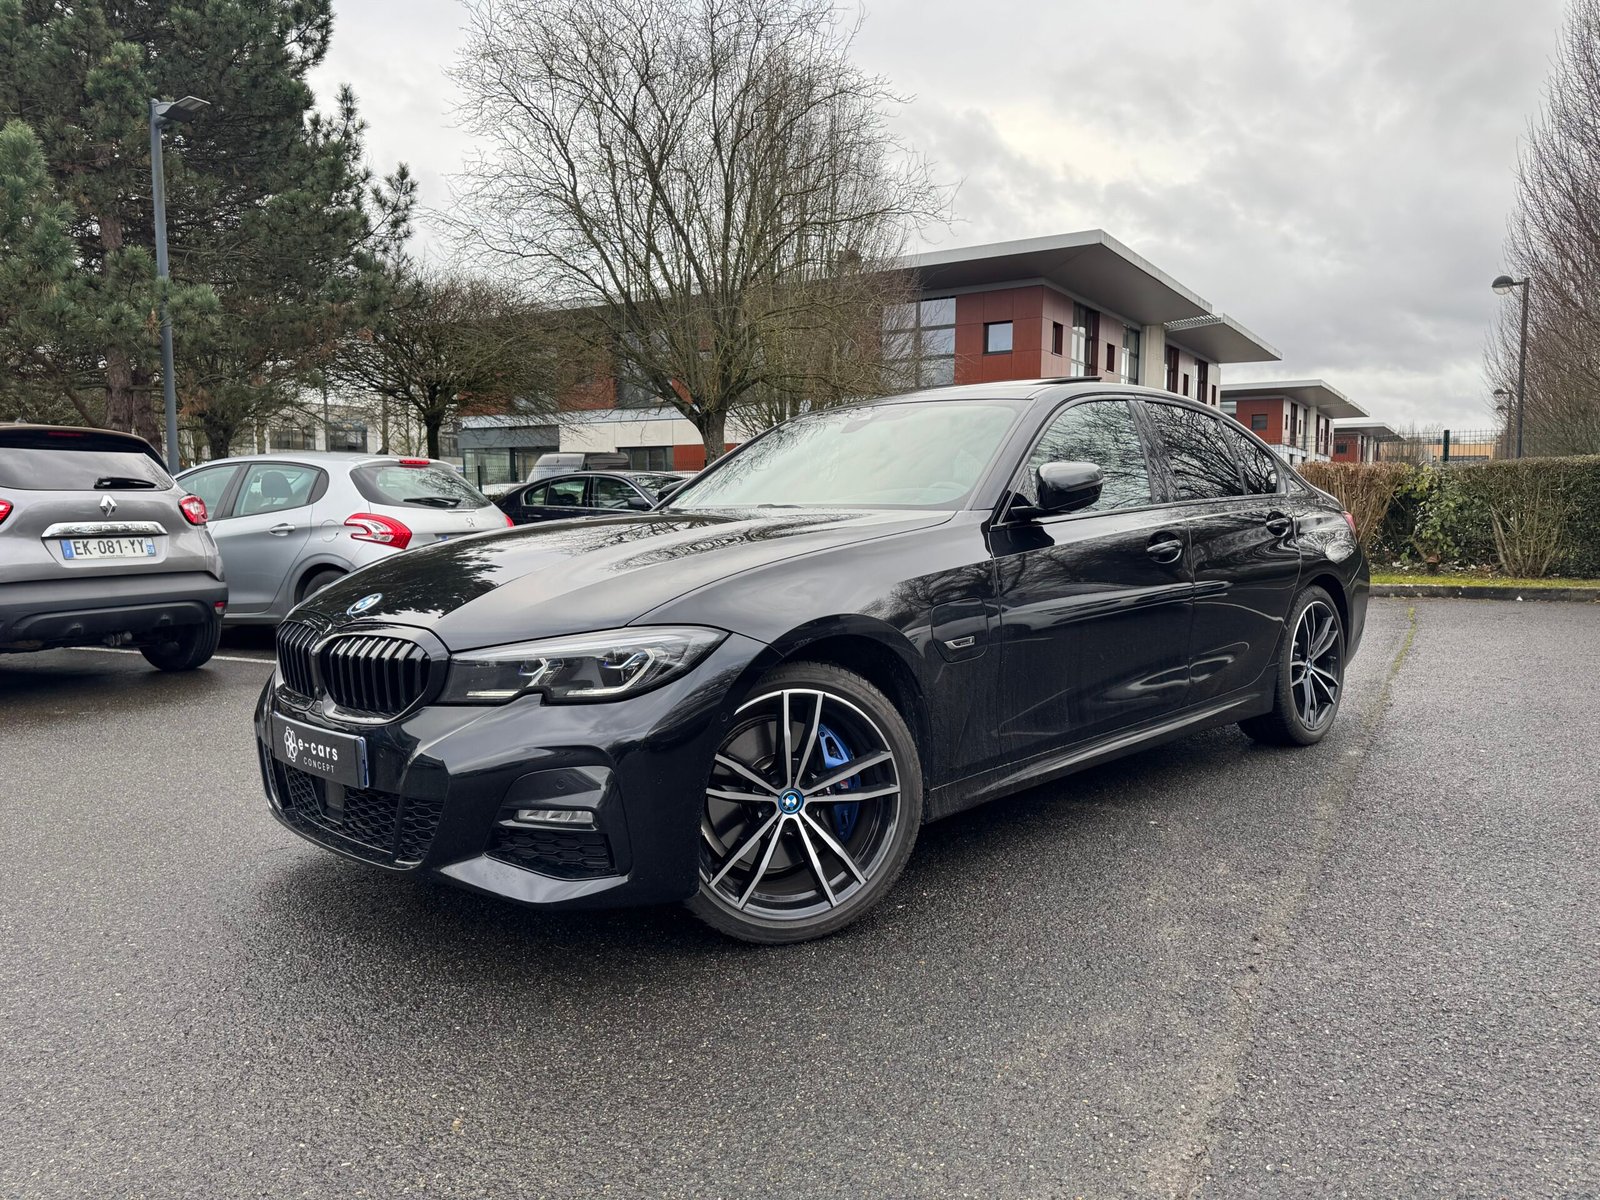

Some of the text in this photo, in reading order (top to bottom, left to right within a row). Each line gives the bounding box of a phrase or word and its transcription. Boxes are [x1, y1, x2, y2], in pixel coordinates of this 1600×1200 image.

[73, 540, 145, 555] EK-081-YY
[298, 738, 338, 761] e-cars
[303, 757, 334, 773] CONCEPT
